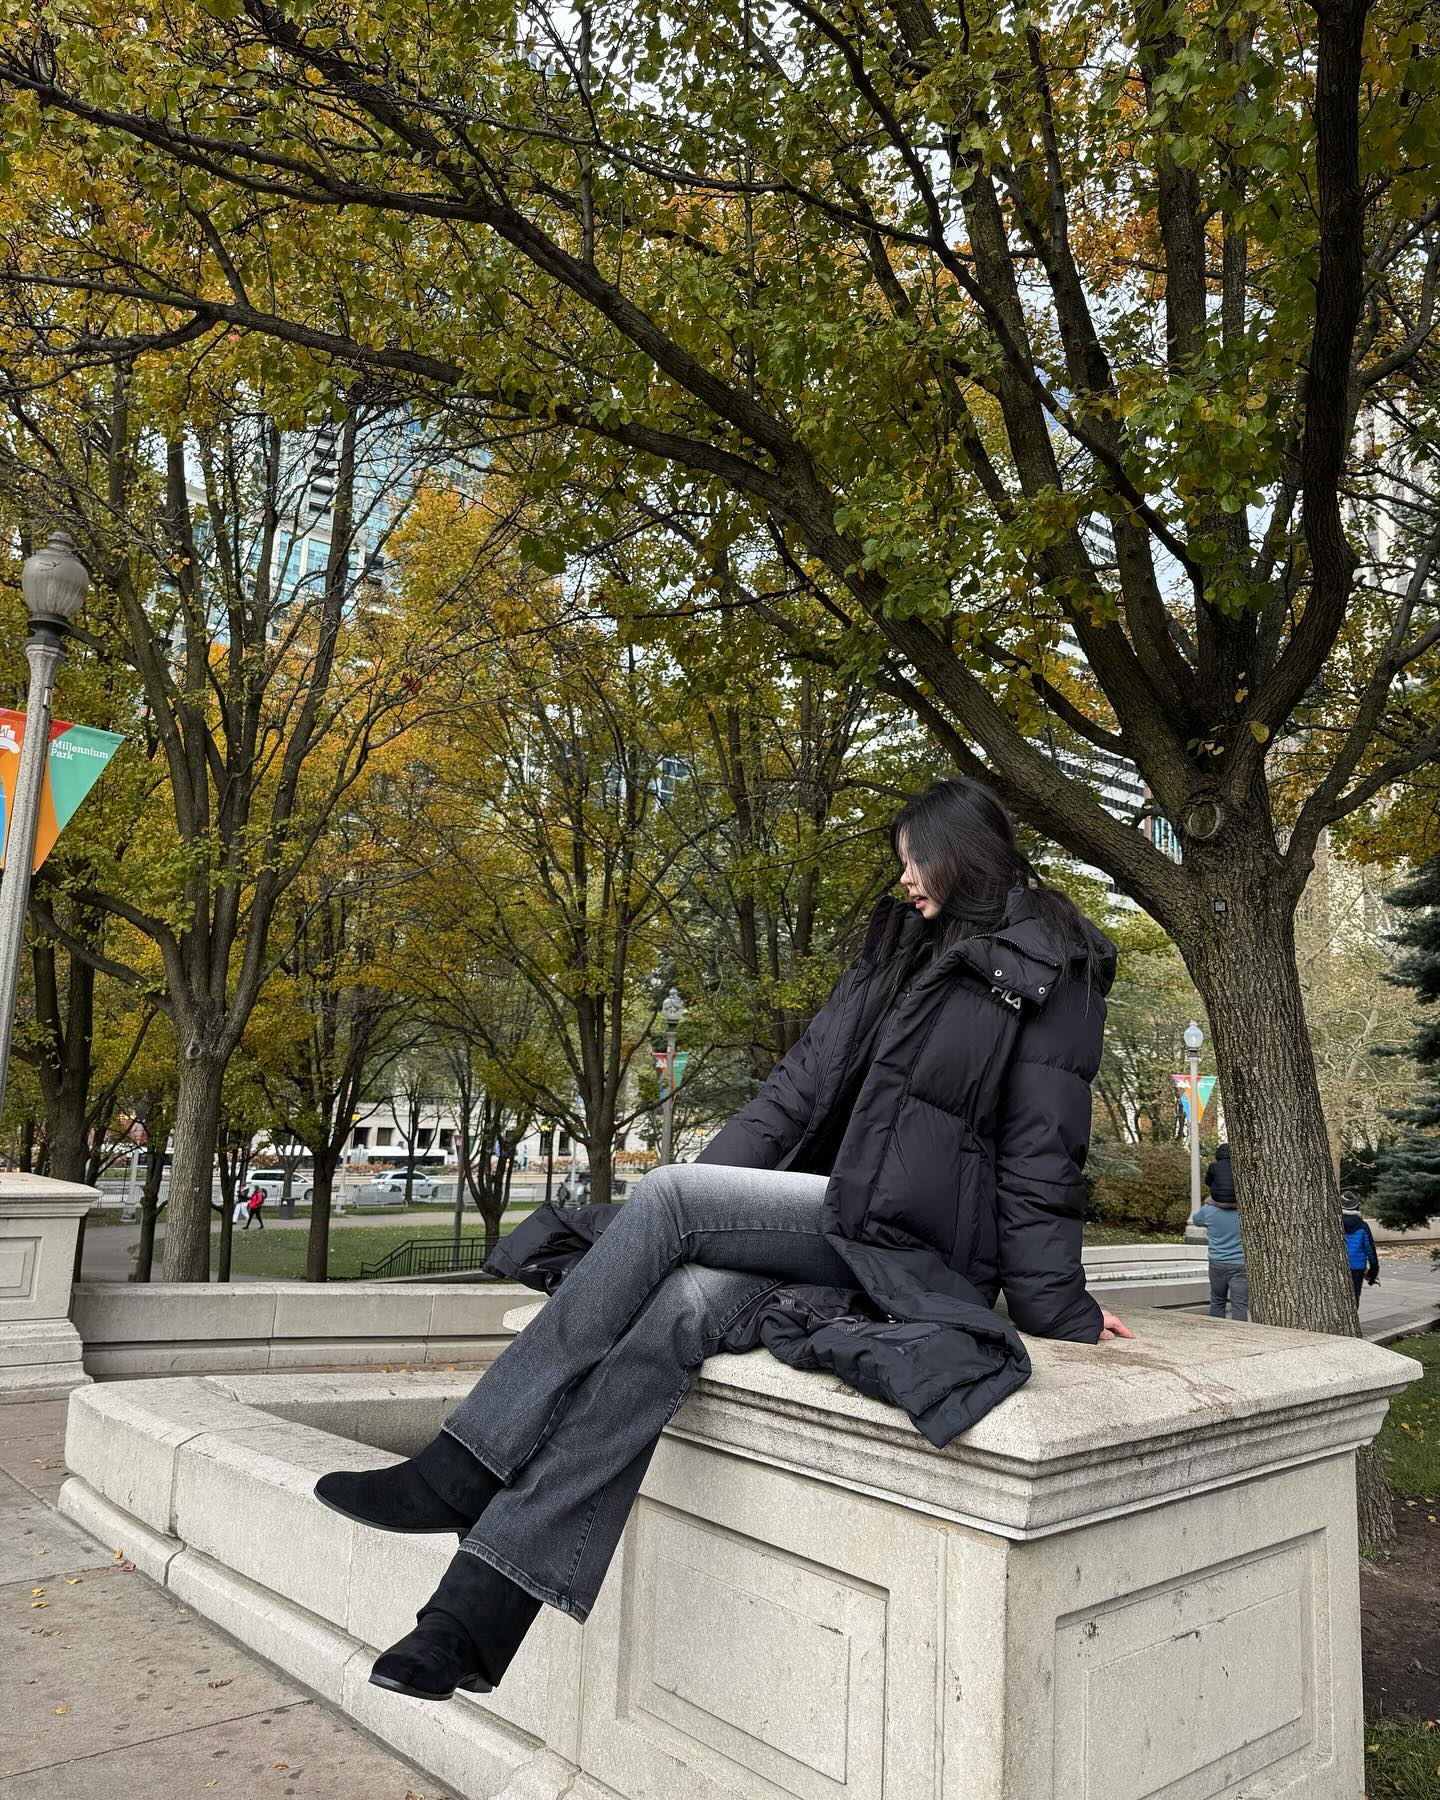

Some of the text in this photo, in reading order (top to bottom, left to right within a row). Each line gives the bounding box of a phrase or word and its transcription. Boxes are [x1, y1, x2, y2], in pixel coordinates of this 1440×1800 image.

[51, 748, 74, 760] Park
[52, 739, 108, 759] Millennium
[991, 985, 1022, 1010] FILA
